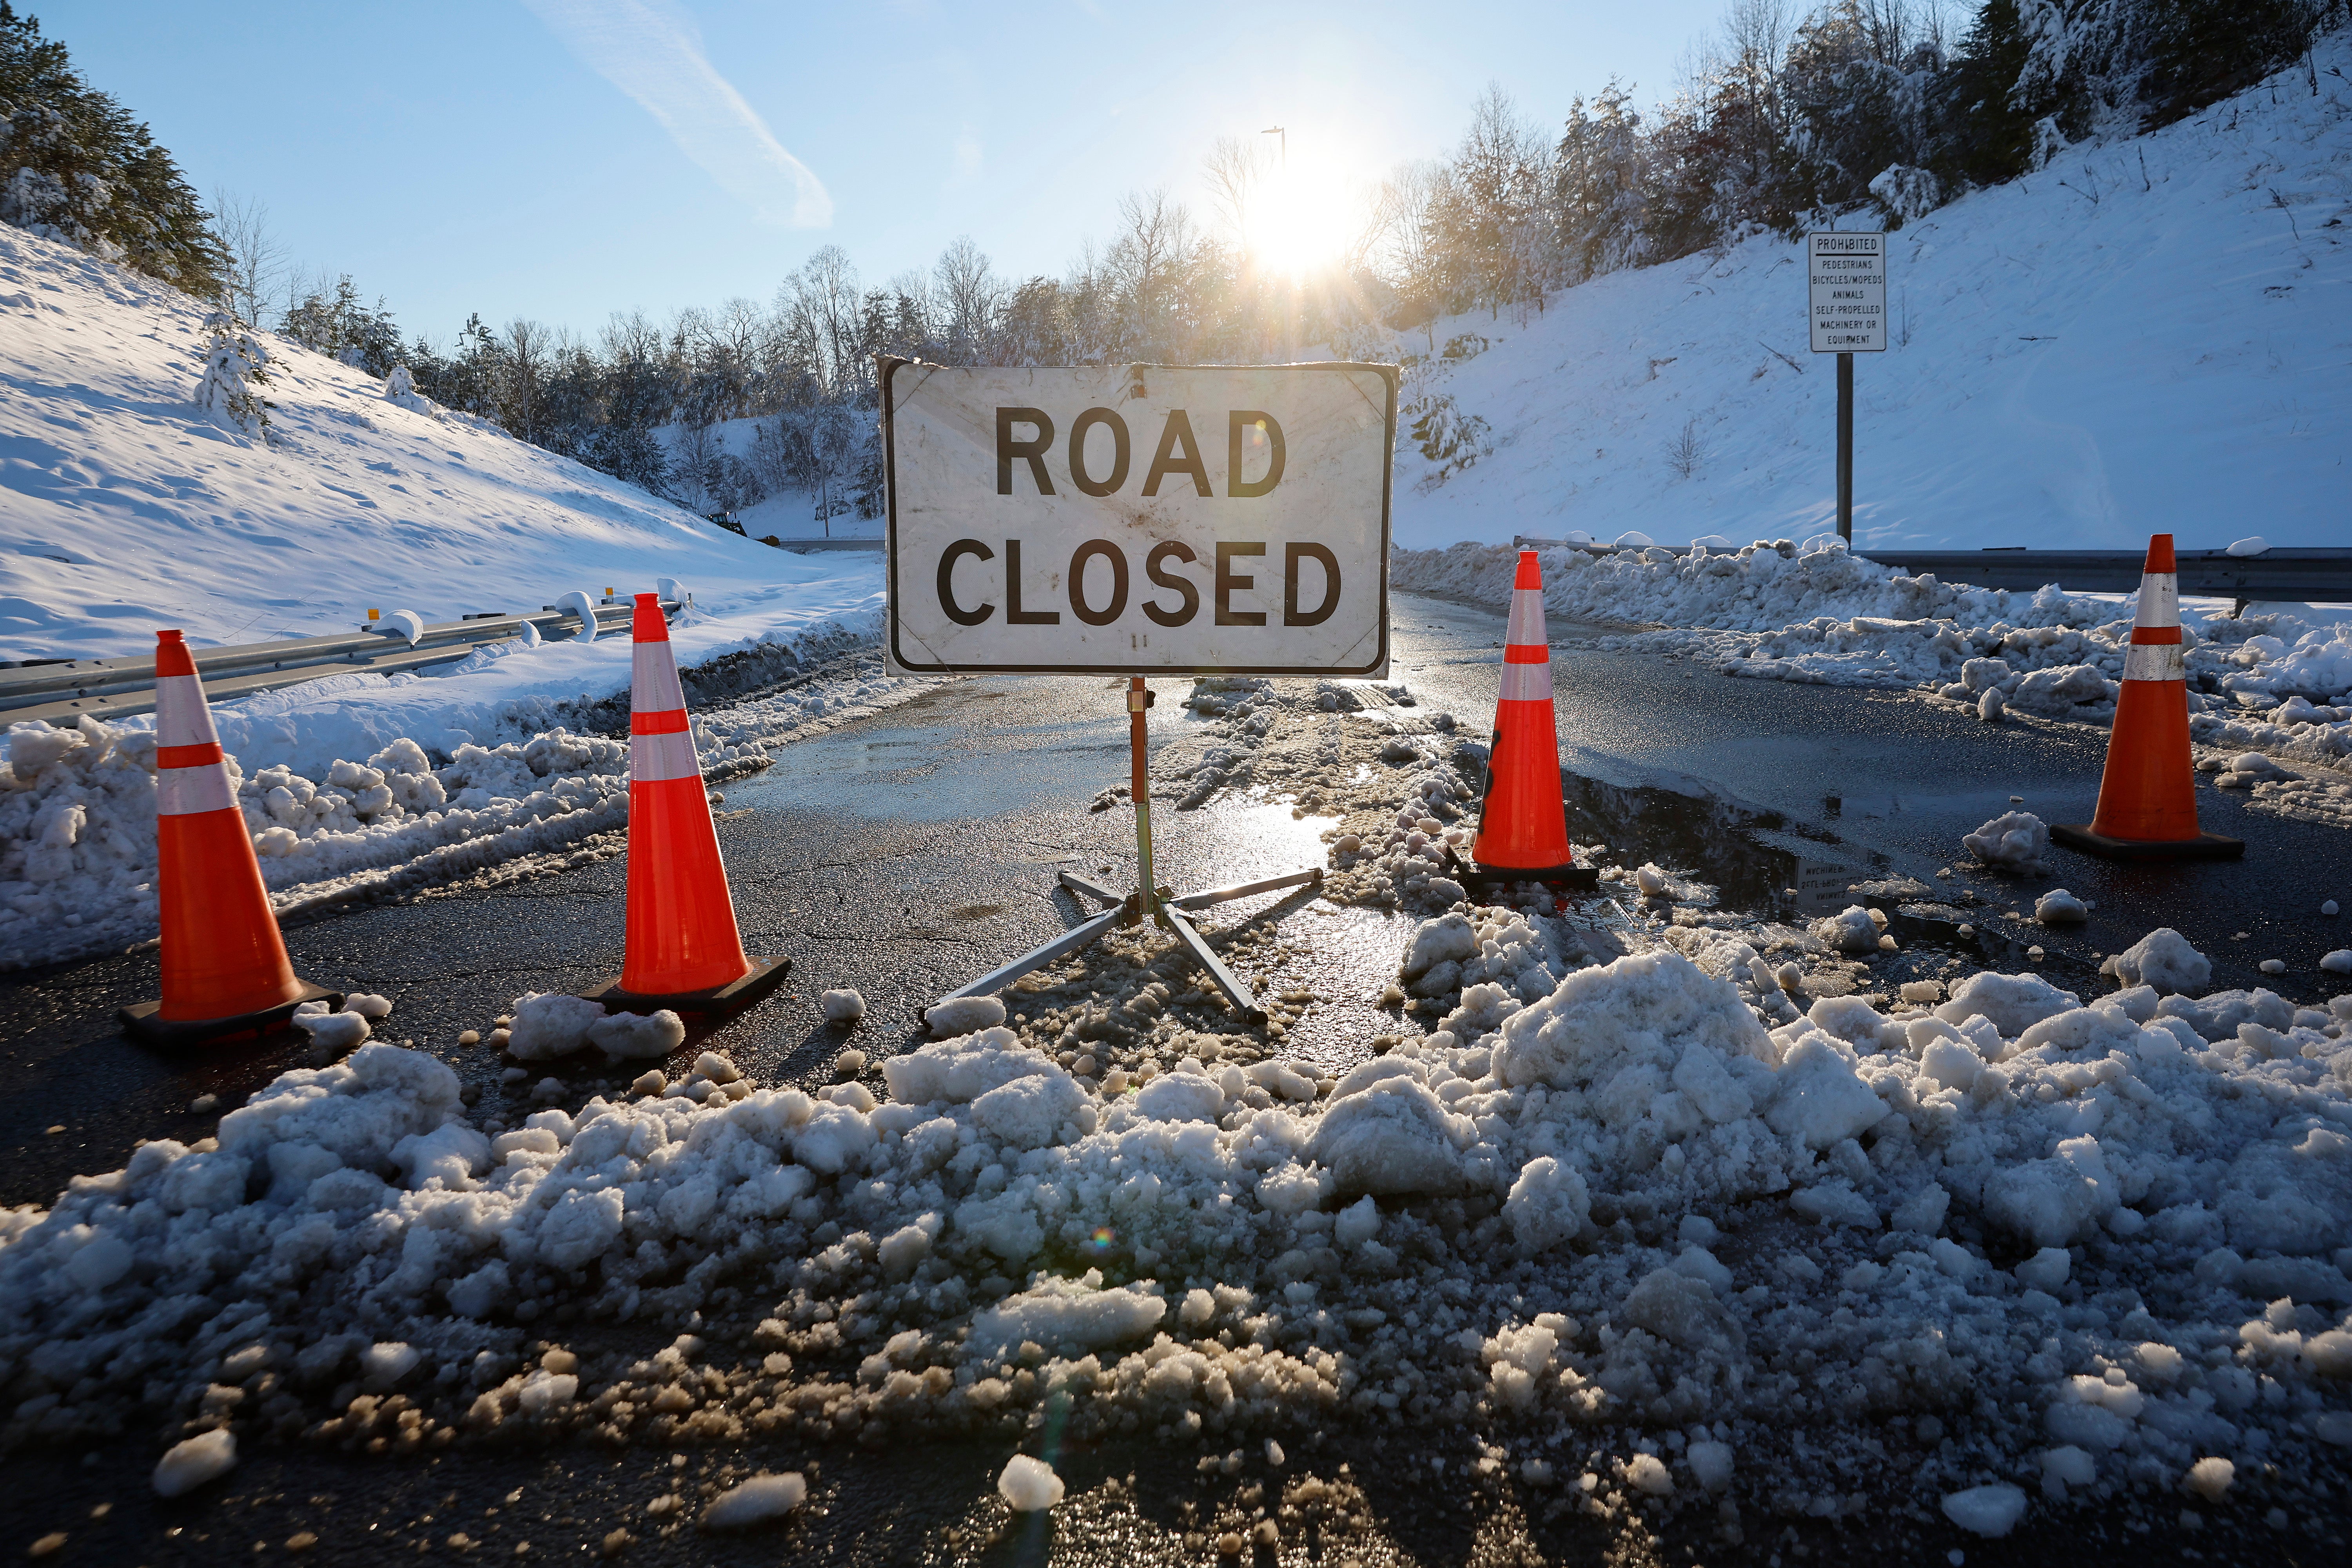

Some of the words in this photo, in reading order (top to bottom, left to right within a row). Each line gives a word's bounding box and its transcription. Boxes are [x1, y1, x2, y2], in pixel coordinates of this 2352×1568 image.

[1817, 239, 1877, 250] PROHIBITED
[1822, 261, 1872, 269] PEDESTRIANS
[1812, 276, 1882, 284] BICYCLES/MOPEDS
[1832, 291, 1864, 299] ANIMALS
[1816, 305, 1880, 314] SELF-PROPELLED
[1820, 321, 1862, 329] MACHINERY
[1828, 335, 1870, 344] EQUIPMENT
[995, 407, 1287, 497] ROAD
[936, 539, 1341, 627] CLOSED
